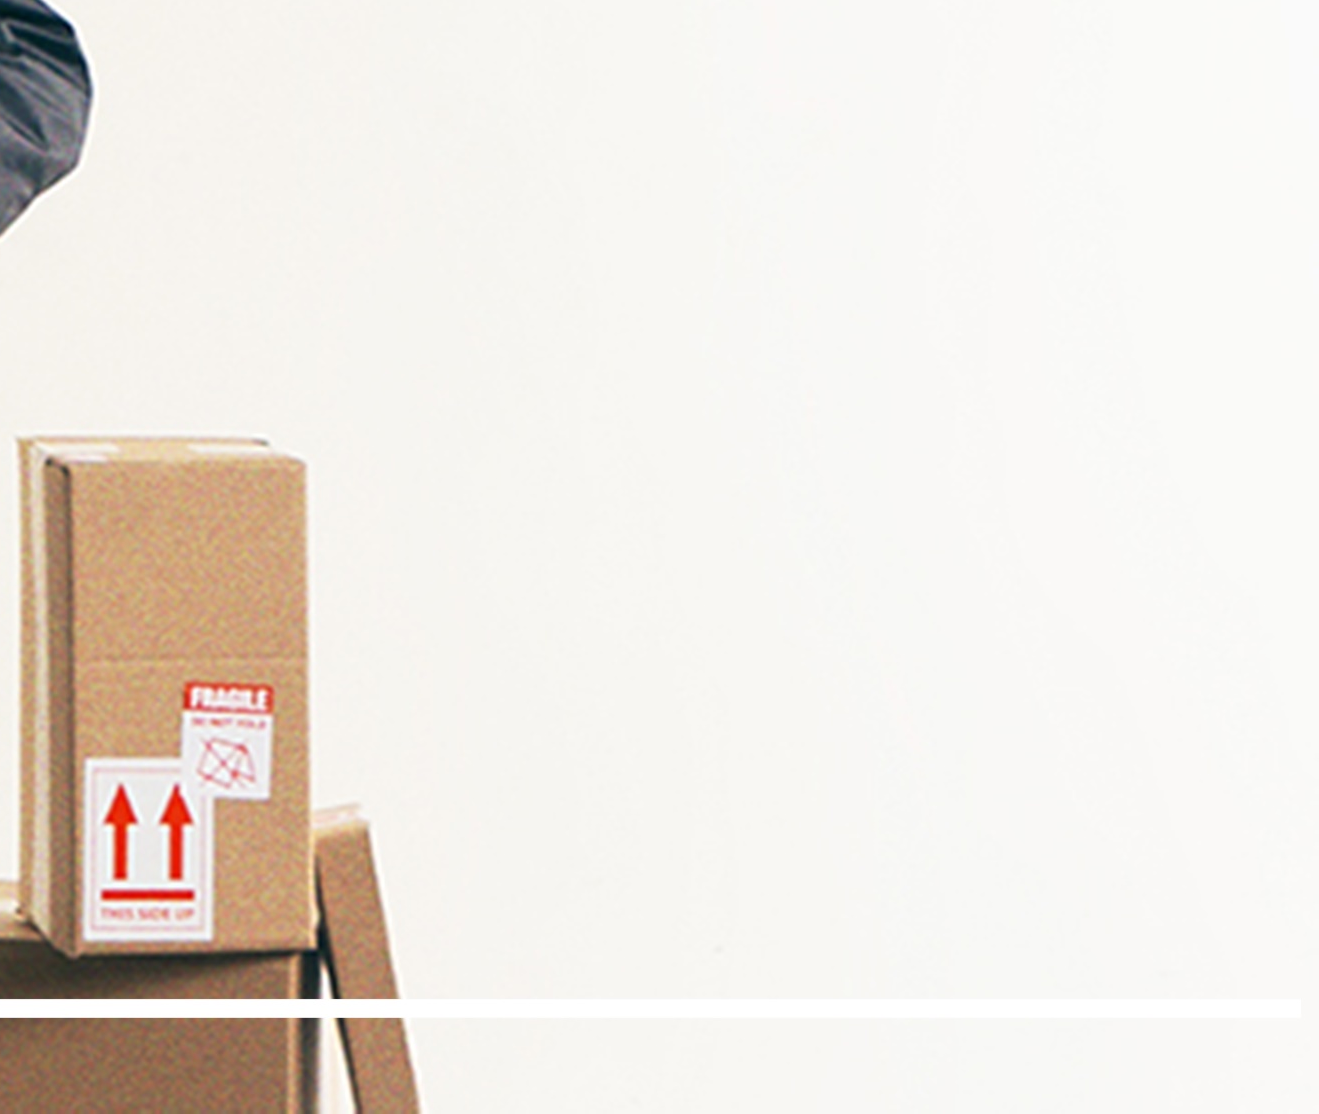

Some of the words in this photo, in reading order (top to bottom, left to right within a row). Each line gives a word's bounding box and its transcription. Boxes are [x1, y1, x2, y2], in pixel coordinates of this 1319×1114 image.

[190, 686, 266, 711] FRAGILE
[101, 907, 134, 921] THIS
[138, 907, 170, 921] SIDE
[174, 907, 195, 921] UP
